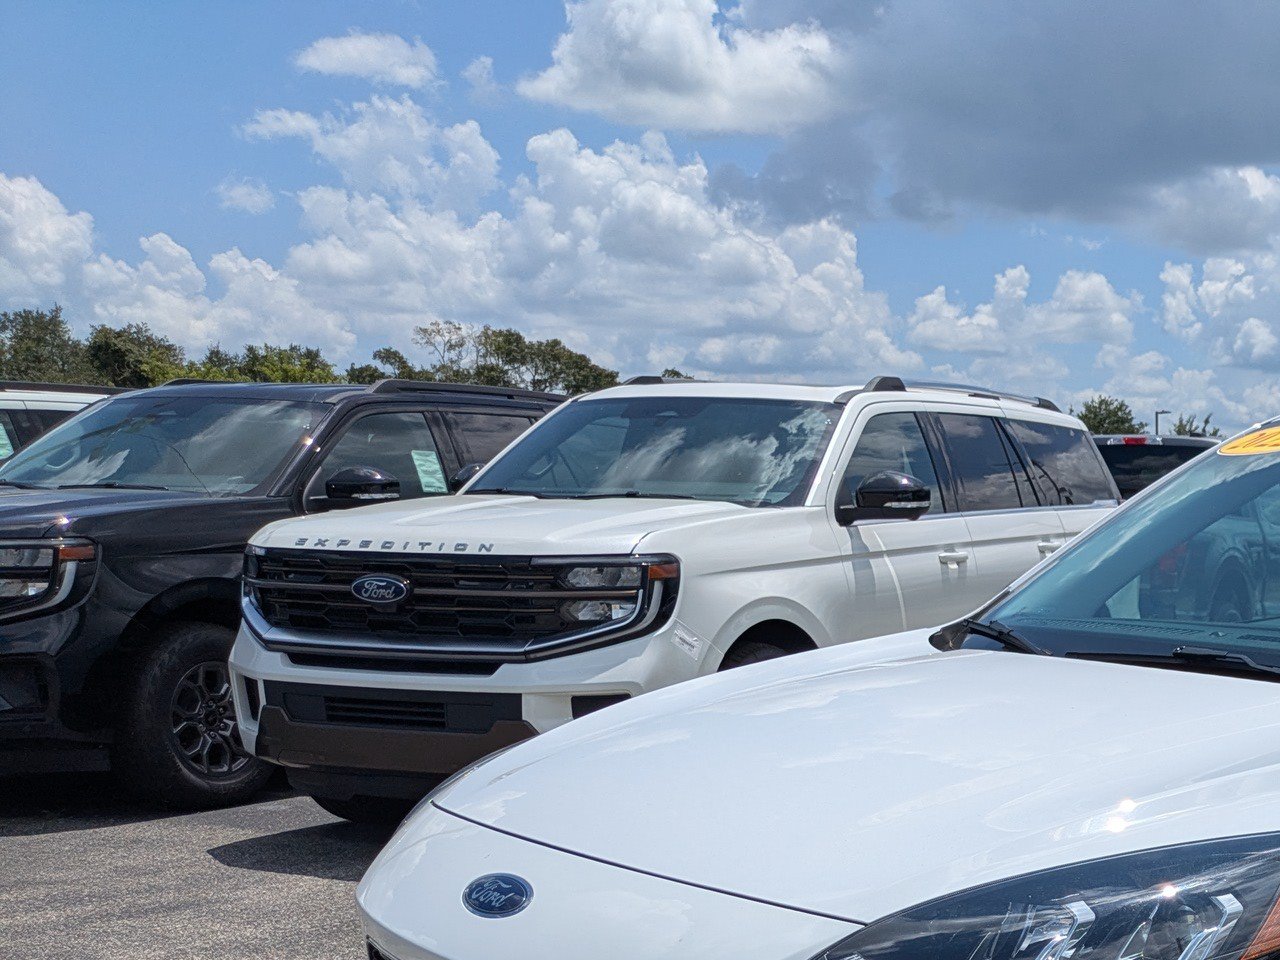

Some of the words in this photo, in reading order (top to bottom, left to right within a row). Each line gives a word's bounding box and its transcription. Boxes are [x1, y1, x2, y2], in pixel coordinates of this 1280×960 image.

[295, 537, 494, 553] EXPEDITION
[361, 580, 395, 599] Ford
[471, 879, 515, 907] Ford
